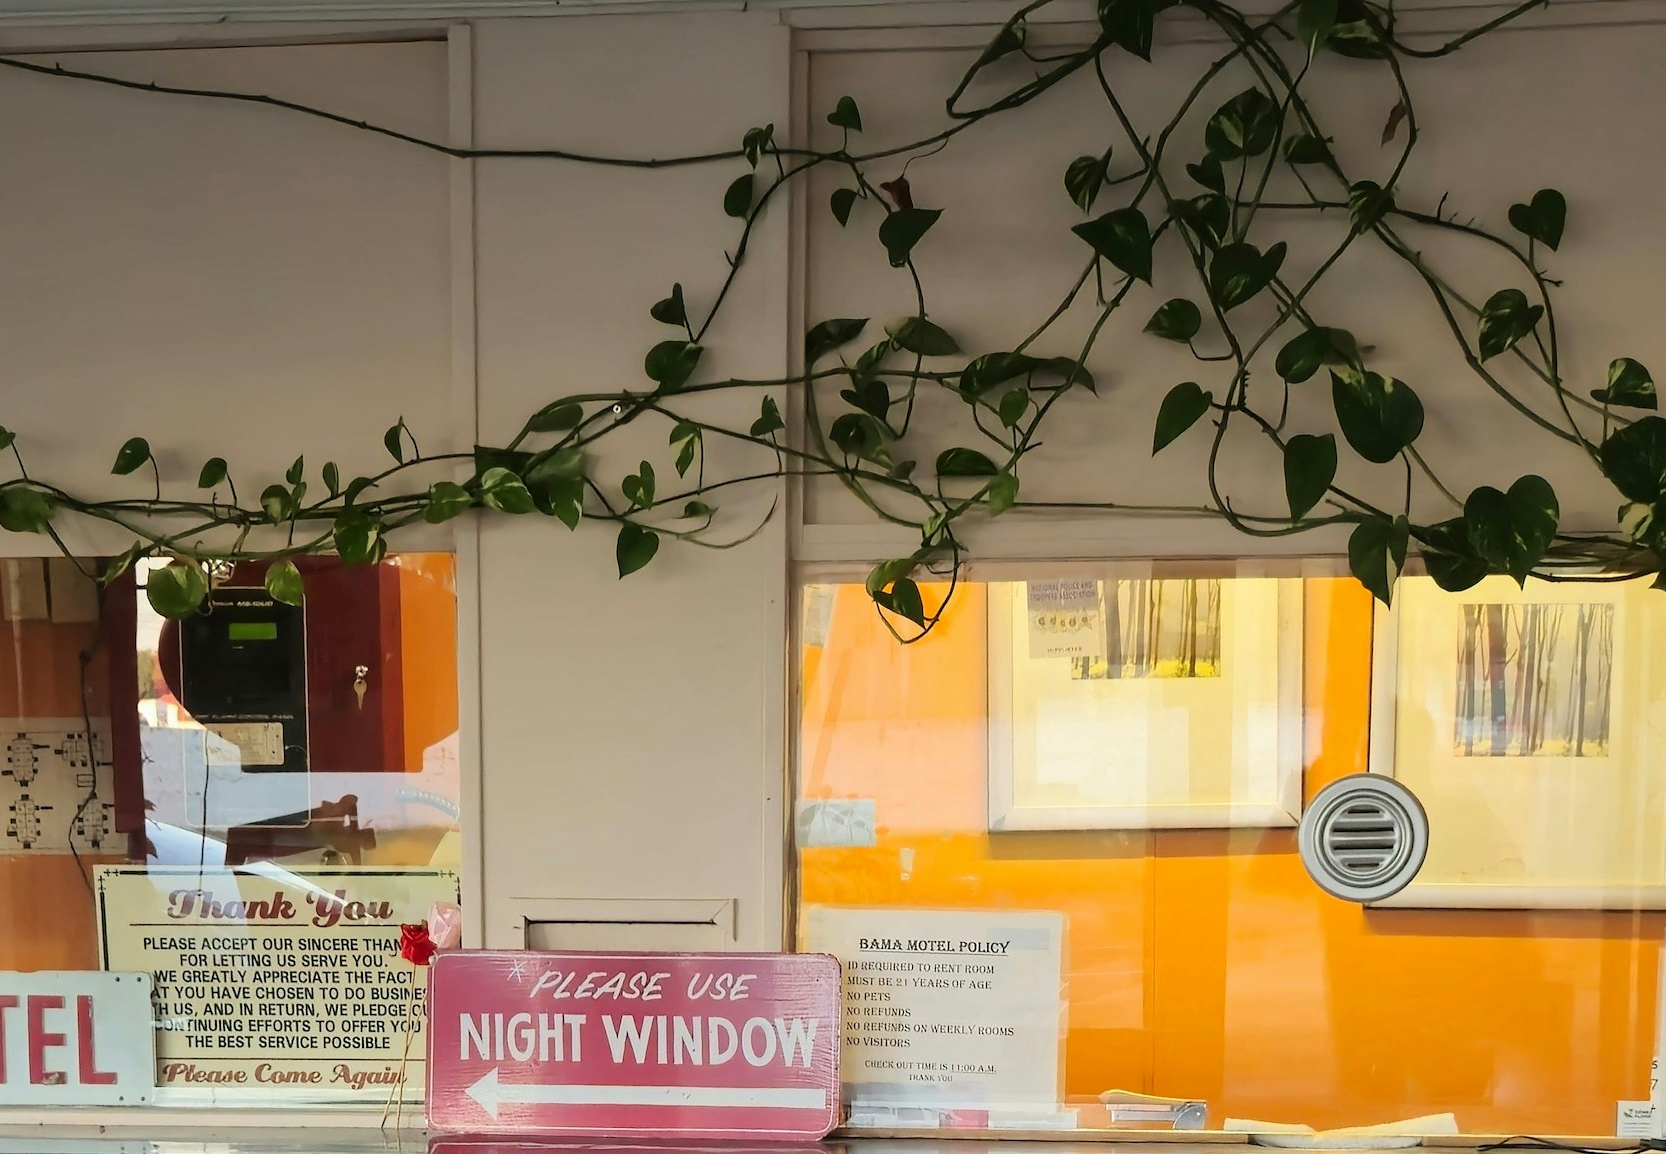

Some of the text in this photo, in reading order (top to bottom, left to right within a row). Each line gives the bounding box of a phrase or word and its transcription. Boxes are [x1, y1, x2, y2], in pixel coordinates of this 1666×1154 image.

[167, 888, 393, 928] Thank You
[143, 937, 402, 951] PLEASE ACCEPT OUR SINCERE THAN
[859, 938, 1011, 953] BAMA MOTEL POLICY
[180, 954, 389, 968] FOR LETTING US SERVE YOU.
[847, 960, 995, 974] ID REQUIRED TO RENT ROOM
[153, 970, 413, 984] WE GREATLY APPRECIATE THE FACT
[847, 976, 992, 989] MUST BE 21 YEARS OF AGE
[174, 986, 205, 999] YOU
[210, 986, 251, 999] HAVE
[255, 986, 315, 1000] CHOSEN
[319, 987, 339, 1000] TO
[344, 987, 366, 1000] DO
[529, 971, 757, 1001] PLEASE USE
[846, 991, 891, 1002] NO PETS
[173, 1002, 198, 1017] US,
[203, 1003, 234, 1016] AND
[239, 1003, 253, 1016] IN
[258, 1003, 320, 1018] RETURN,
[324, 1003, 348, 1016] WE
[353, 1003, 407, 1017] PLEDGE
[846, 1006, 911, 1017] NO REFUNDS
[248, 1019, 311, 1032] EFFORTS
[315, 1020, 336, 1033] TO
[341, 1020, 385, 1033] OFFER
[390, 1020, 422, 1033] YOU
[846, 1021, 1014, 1036] NO REFUNDS ON WEEKLY ROOMS
[185, 1035, 391, 1049] THE BEST SERVICE POSSIBLE
[459, 1012, 820, 1068] NIGHT WINDOW
[846, 1036, 911, 1048] NO VISITORS
[865, 1060, 997, 1073] CHECK OUT TIME IS 11:00 A.M.
[162, 1062, 408, 1090] Please Come Again
[937, 1074, 953, 1082] YOU
